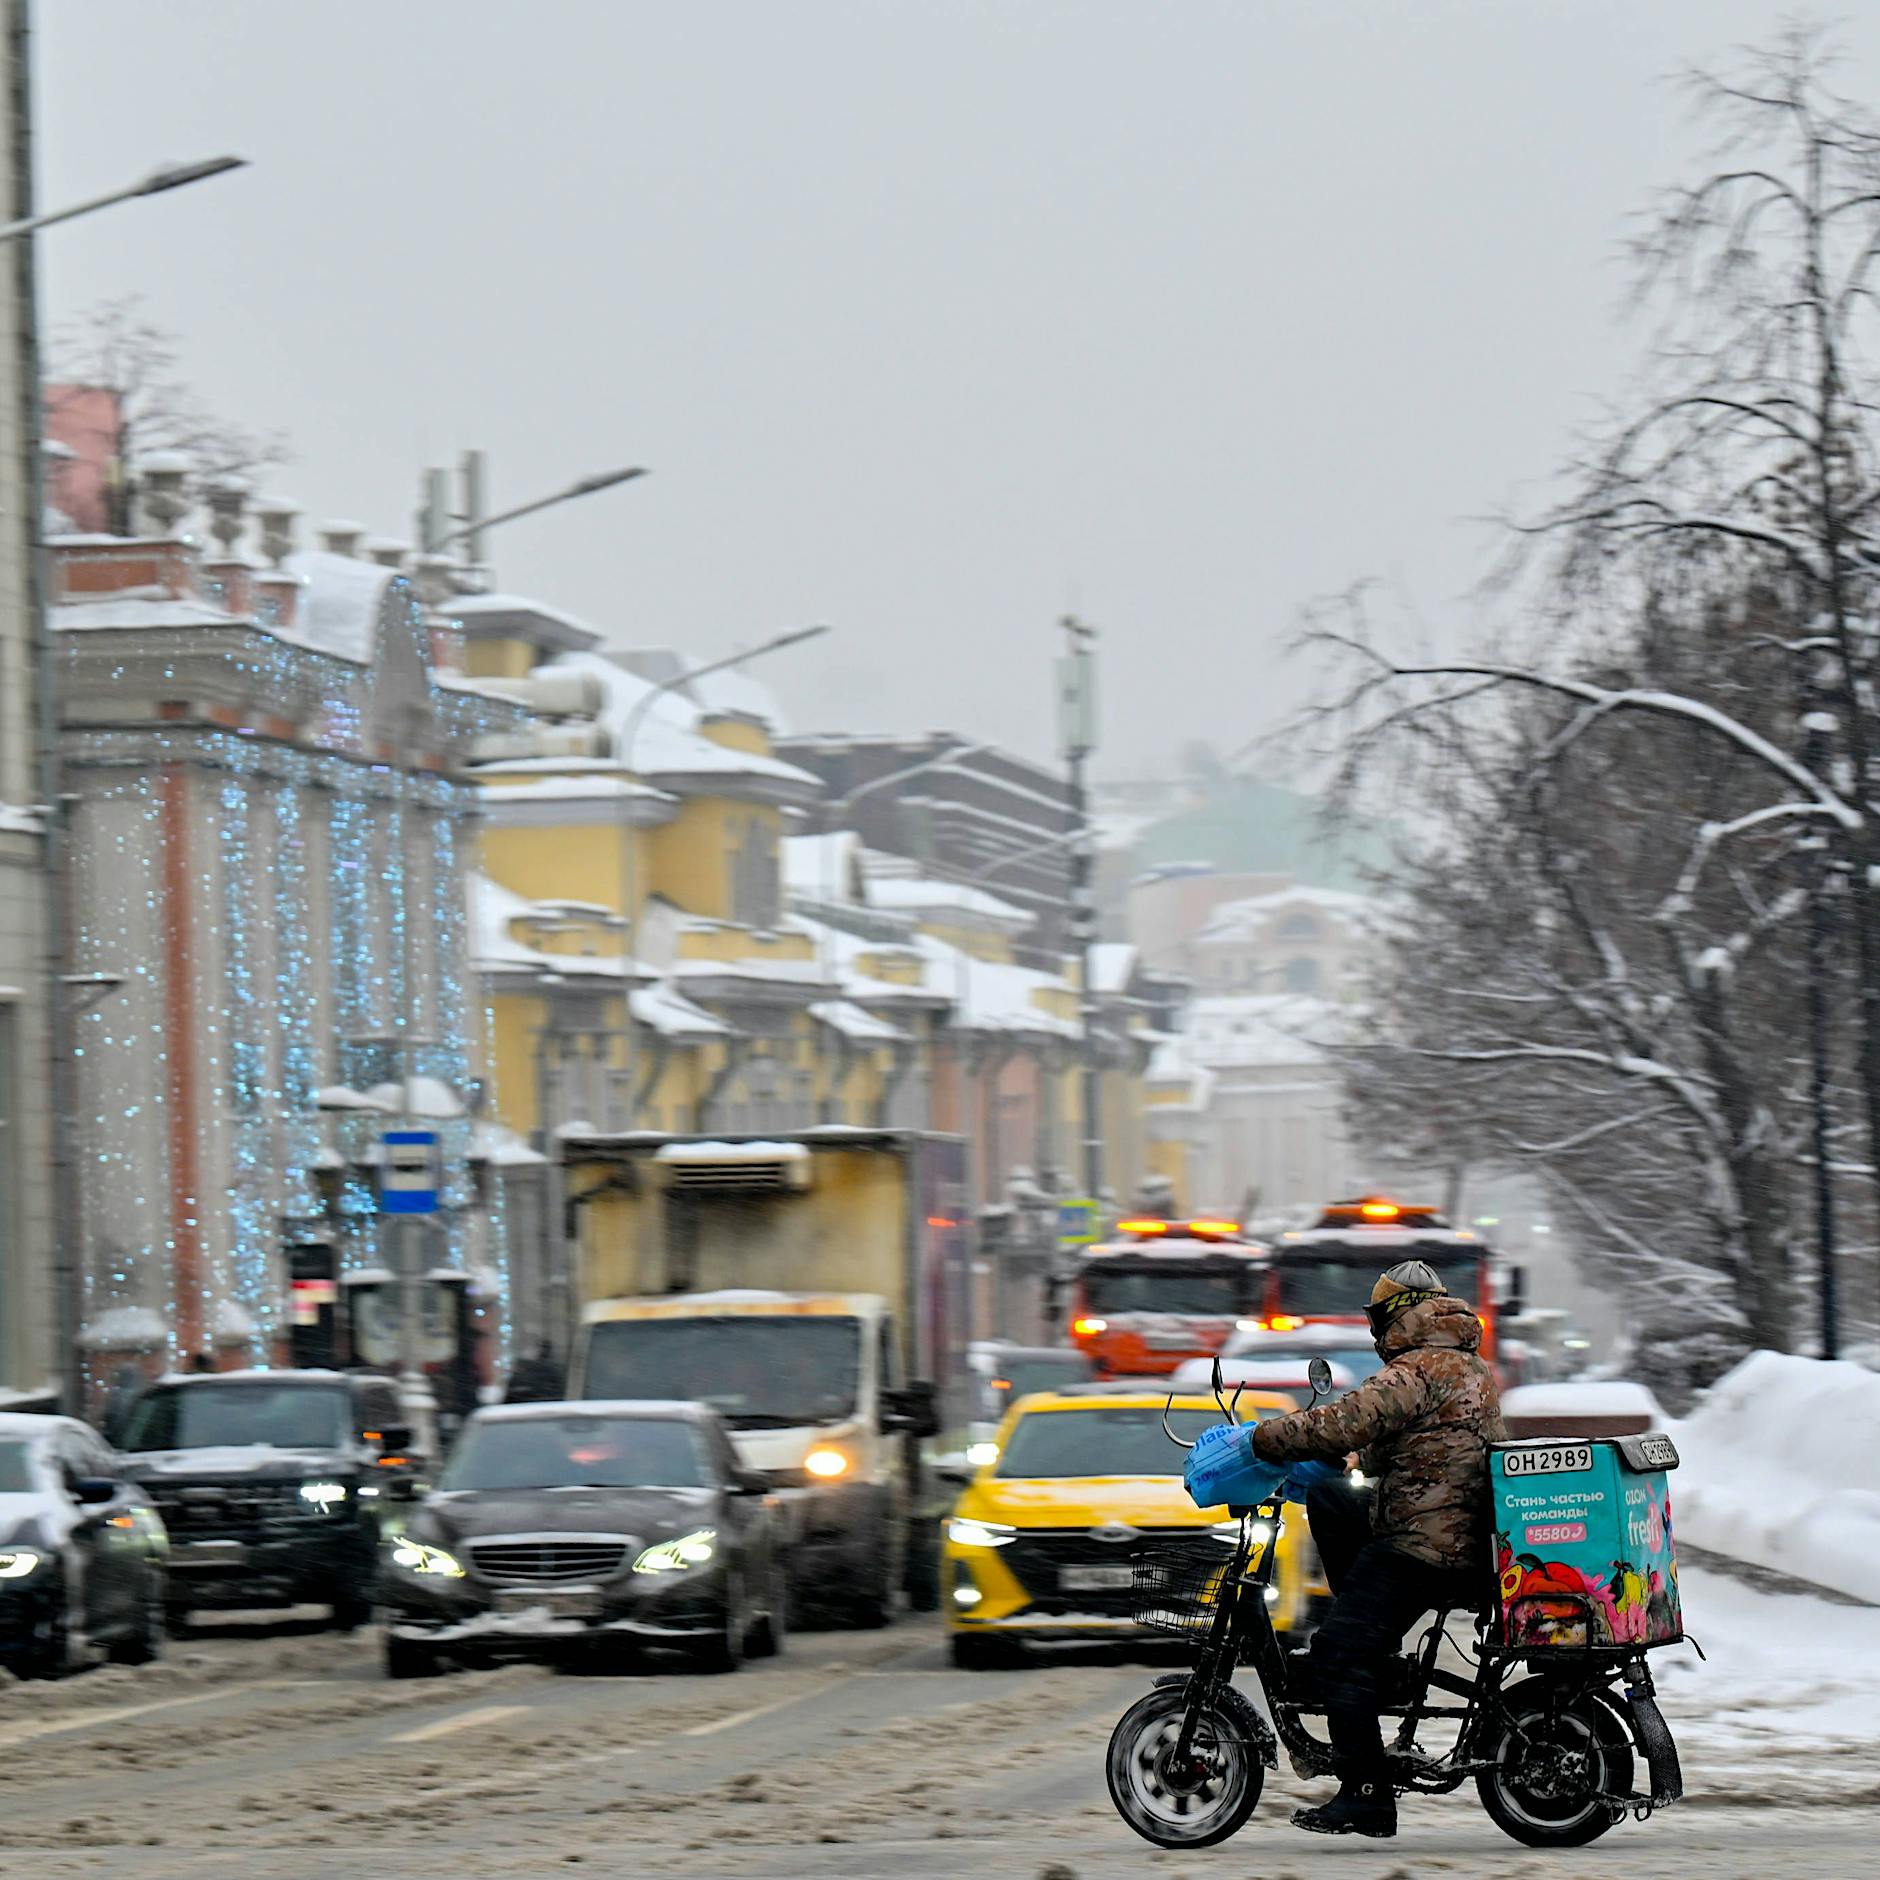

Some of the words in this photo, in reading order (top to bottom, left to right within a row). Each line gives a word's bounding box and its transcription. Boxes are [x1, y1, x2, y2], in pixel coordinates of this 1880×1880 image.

[1505, 1494, 1546, 1508] Стань
[1550, 1491, 1604, 1505] частью
[1521, 1508, 1588, 1521] команды
[1628, 1510, 1659, 1546] fresh
